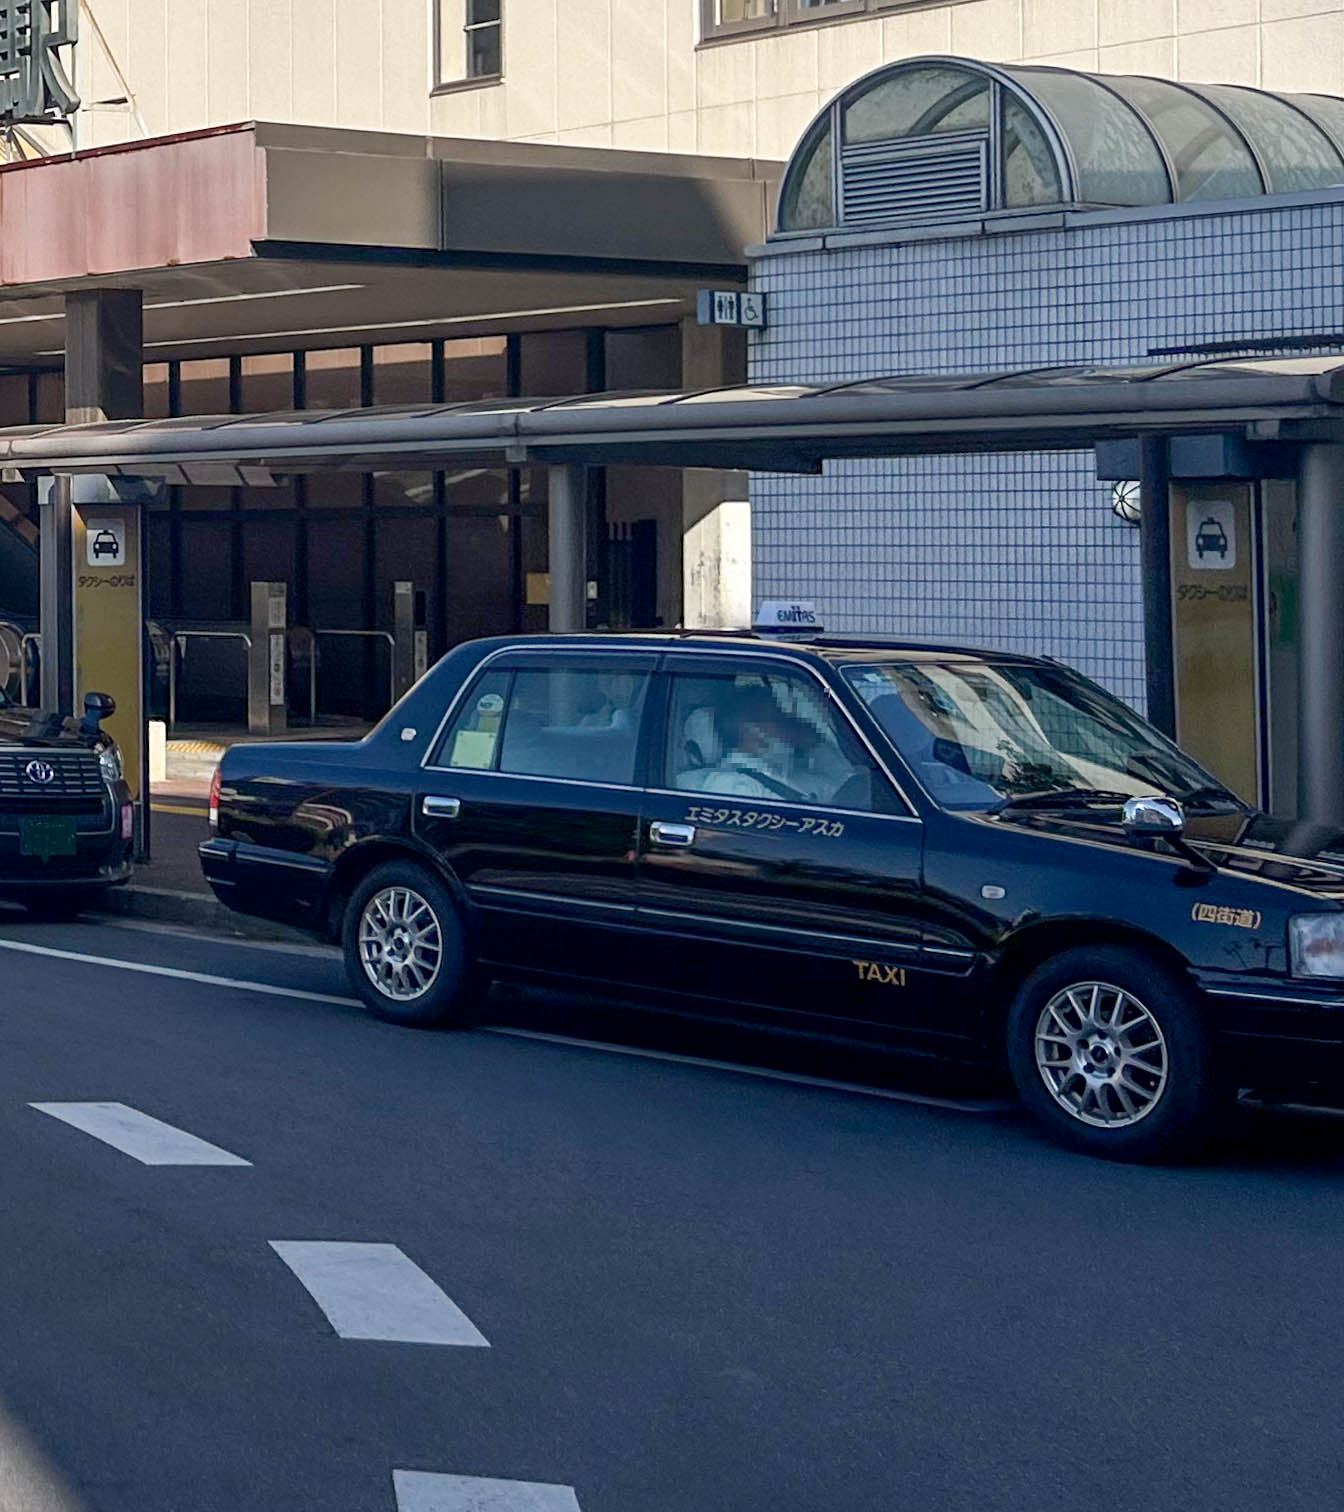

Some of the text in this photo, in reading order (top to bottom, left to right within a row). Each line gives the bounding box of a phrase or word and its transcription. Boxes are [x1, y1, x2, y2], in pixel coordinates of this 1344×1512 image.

[77, 575, 136, 588] タクシーのりば
[684, 806, 846, 838] エミタスタクシーアスカ
[1191, 902, 1262, 929] (四街道)
[852, 960, 906, 987] TAXI
